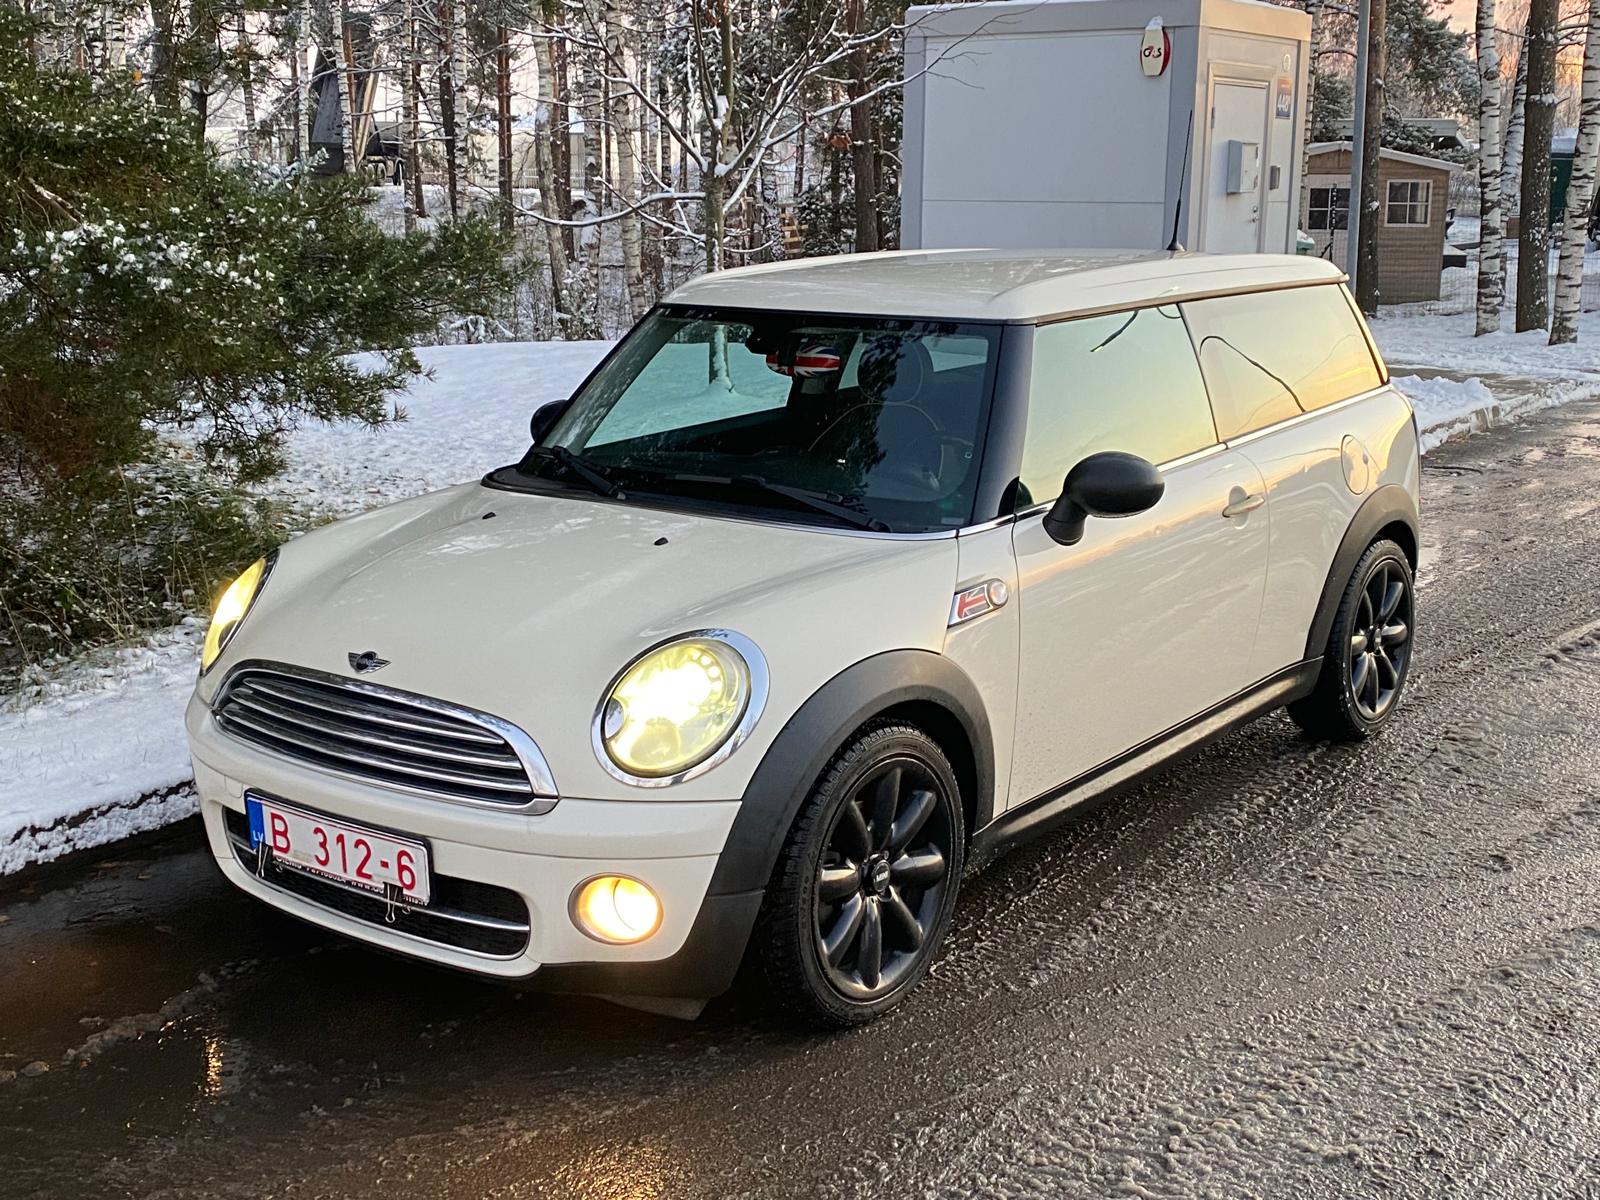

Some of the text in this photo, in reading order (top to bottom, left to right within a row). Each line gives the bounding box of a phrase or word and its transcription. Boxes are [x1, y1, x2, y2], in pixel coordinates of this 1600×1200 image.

[252, 829, 264, 842] LV
[270, 812, 416, 891] B 312-6
